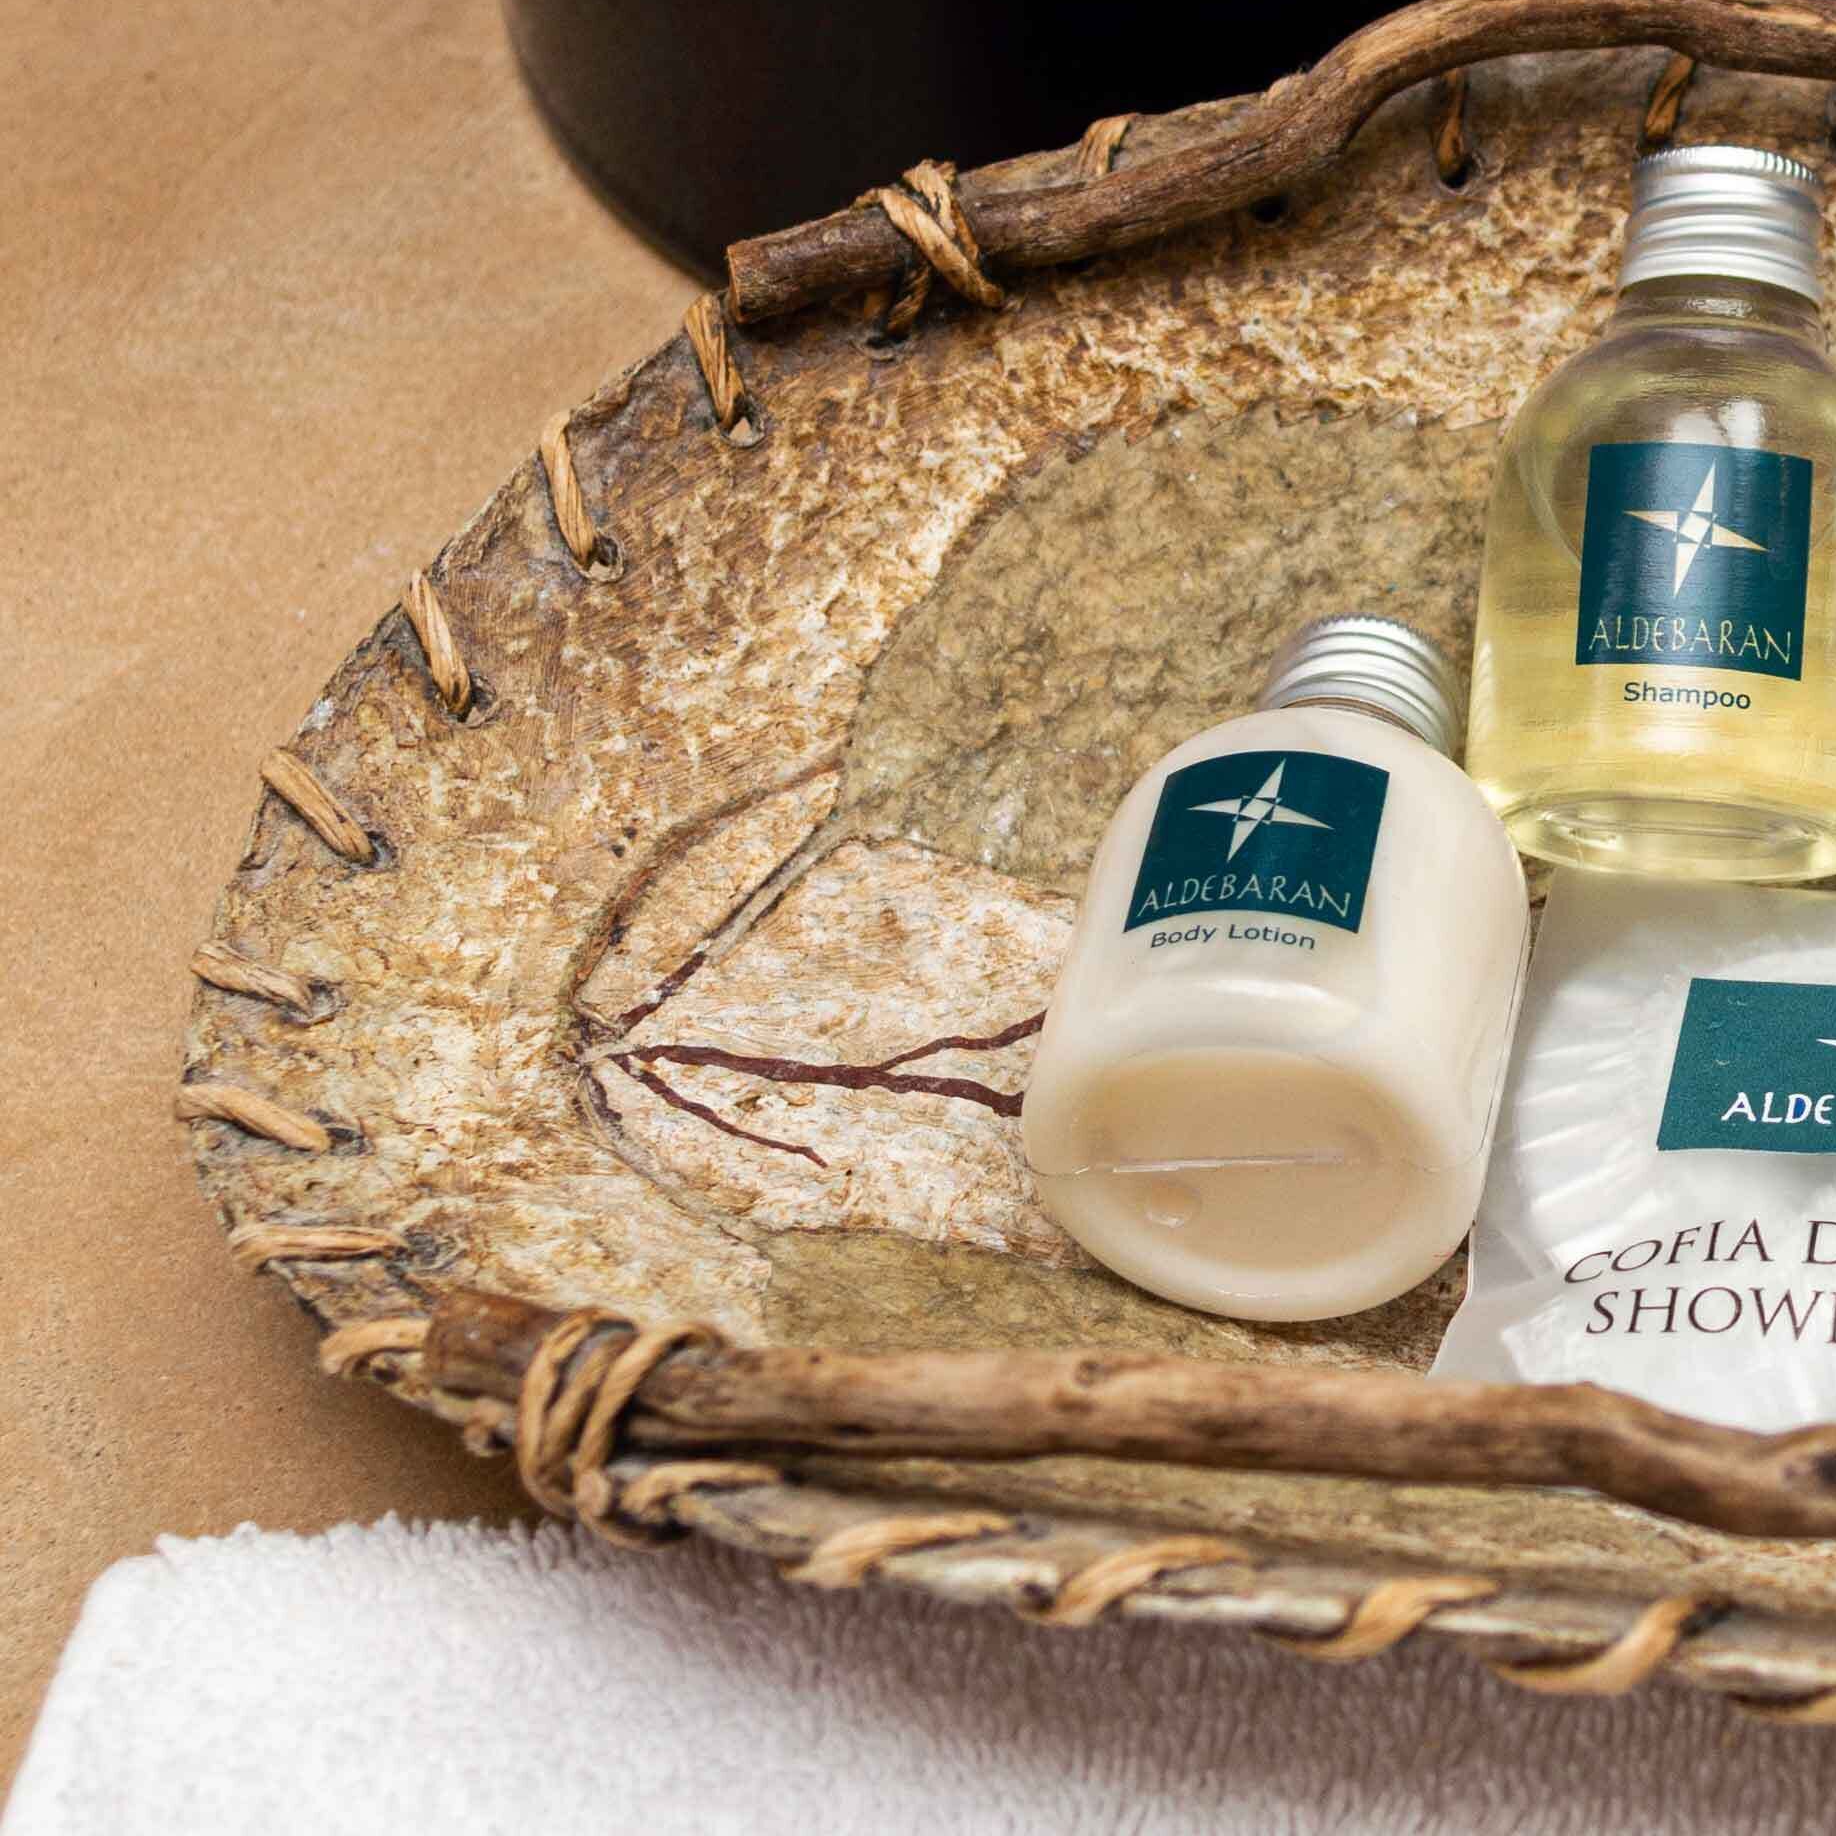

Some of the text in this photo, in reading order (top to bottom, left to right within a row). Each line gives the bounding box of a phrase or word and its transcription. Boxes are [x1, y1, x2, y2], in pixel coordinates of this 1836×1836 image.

[1588, 615, 1792, 664] ALDEBARAN
[1623, 681, 1752, 710] Shampoo
[1137, 873, 1351, 918] ALDEBARAN
[1150, 924, 1316, 950] Body Lotion
[1564, 1218, 1772, 1285] COFIA
